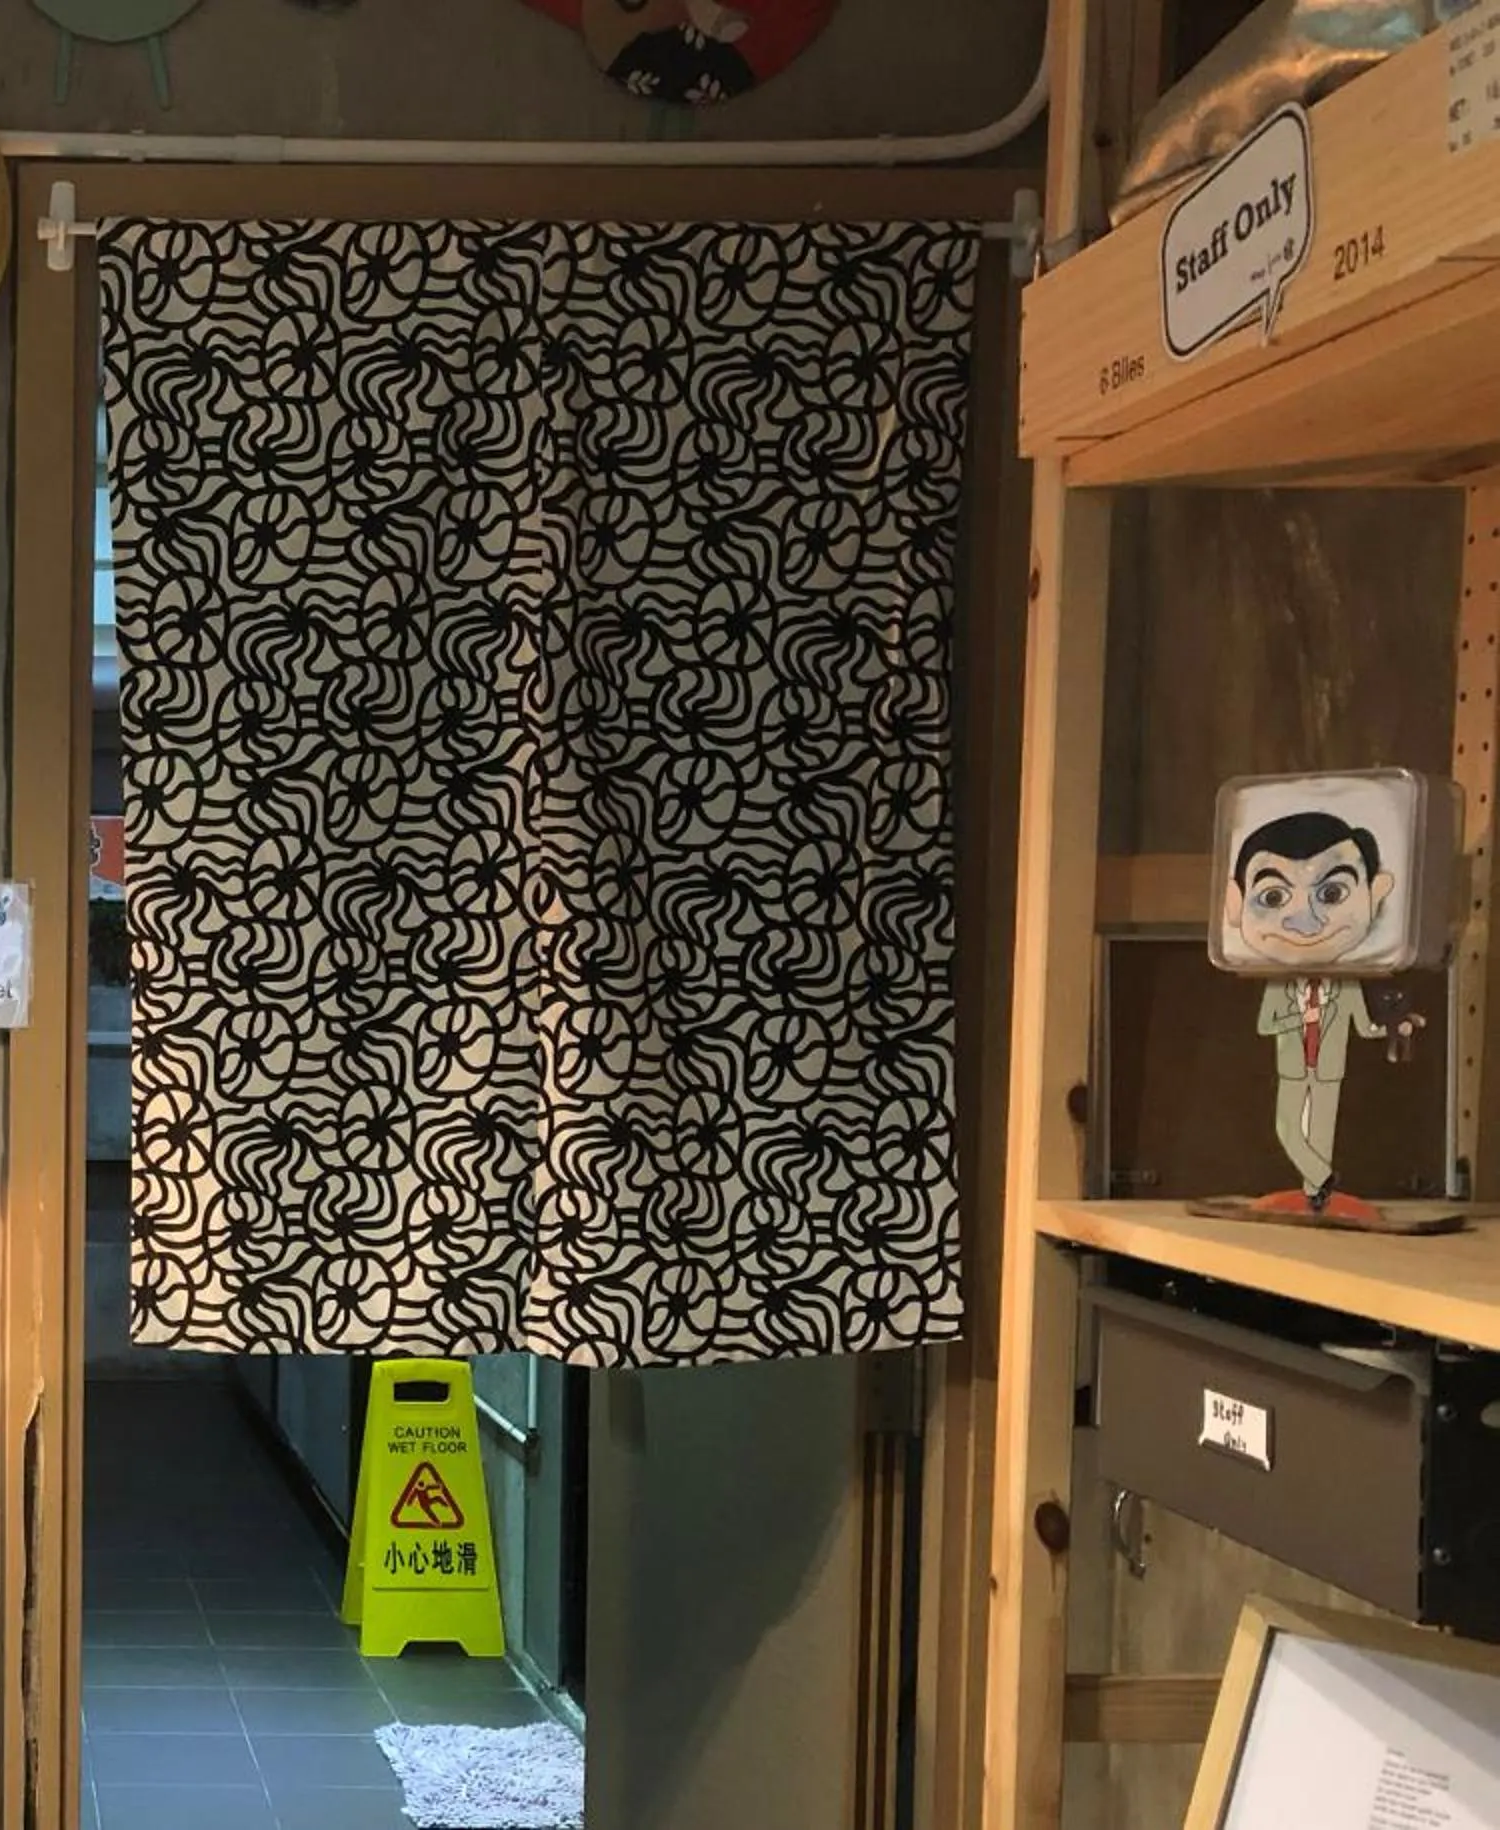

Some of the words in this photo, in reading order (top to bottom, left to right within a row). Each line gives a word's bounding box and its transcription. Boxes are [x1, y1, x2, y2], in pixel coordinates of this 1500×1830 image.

[1176, 220, 1230, 294] Staff
[1233, 172, 1297, 242] Only
[1333, 224, 1385, 281] 2014
[1213, 1399, 1244, 1426] Staff
[387, 1441, 417, 1454] WET
[422, 1441, 468, 1454] FLOOR
[394, 1425, 461, 1439] CAUTION
[383, 1538, 478, 1576] 小心地滑
